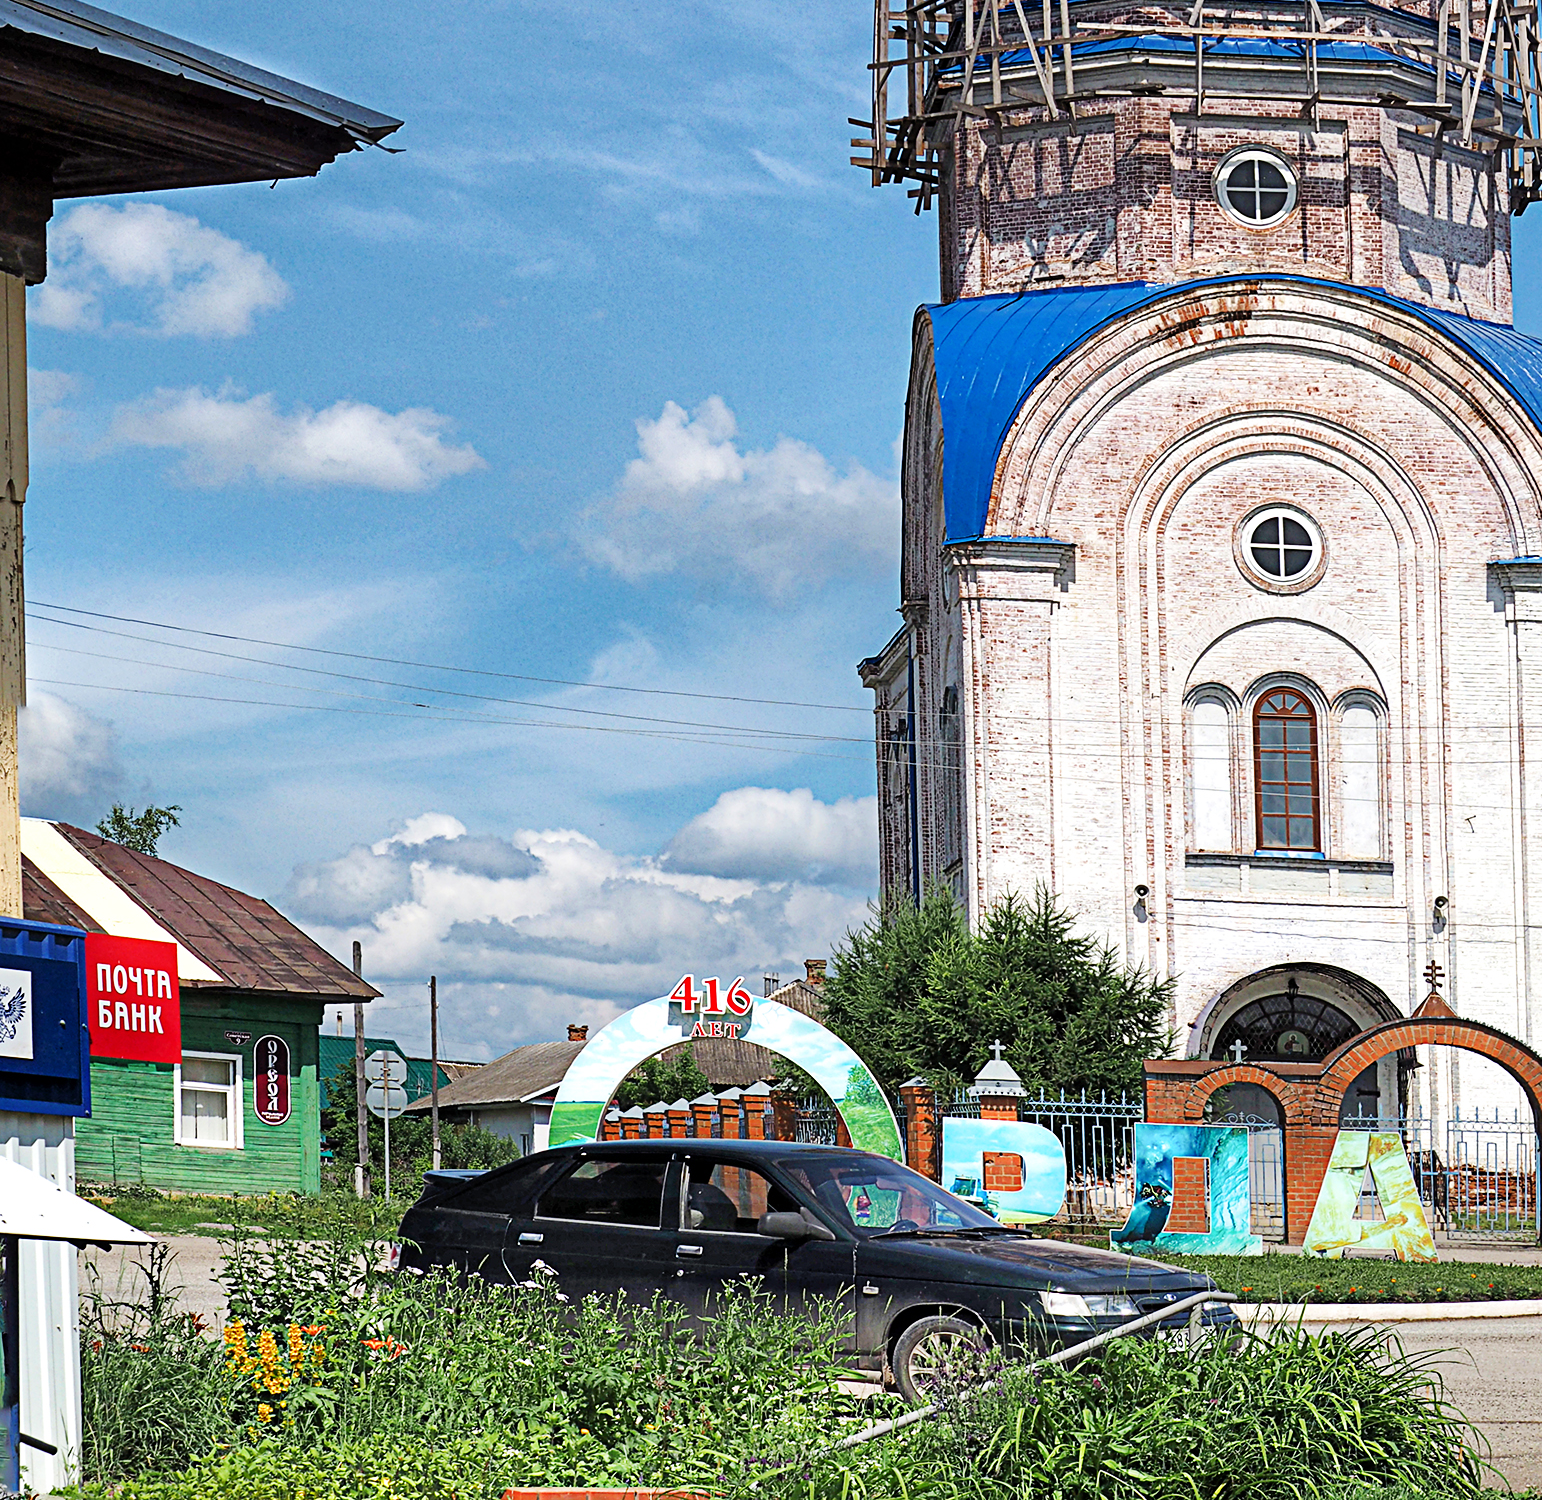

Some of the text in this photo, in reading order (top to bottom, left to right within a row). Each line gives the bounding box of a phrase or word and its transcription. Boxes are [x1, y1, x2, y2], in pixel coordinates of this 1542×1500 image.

[96, 962, 172, 1000] ПОЧТА
[669, 975, 752, 1015] 416
[98, 999, 164, 1035] БАНК
[690, 1021, 741, 1039] ЛЕТ
[267, 1040, 279, 1111] ОРЕОЛ
